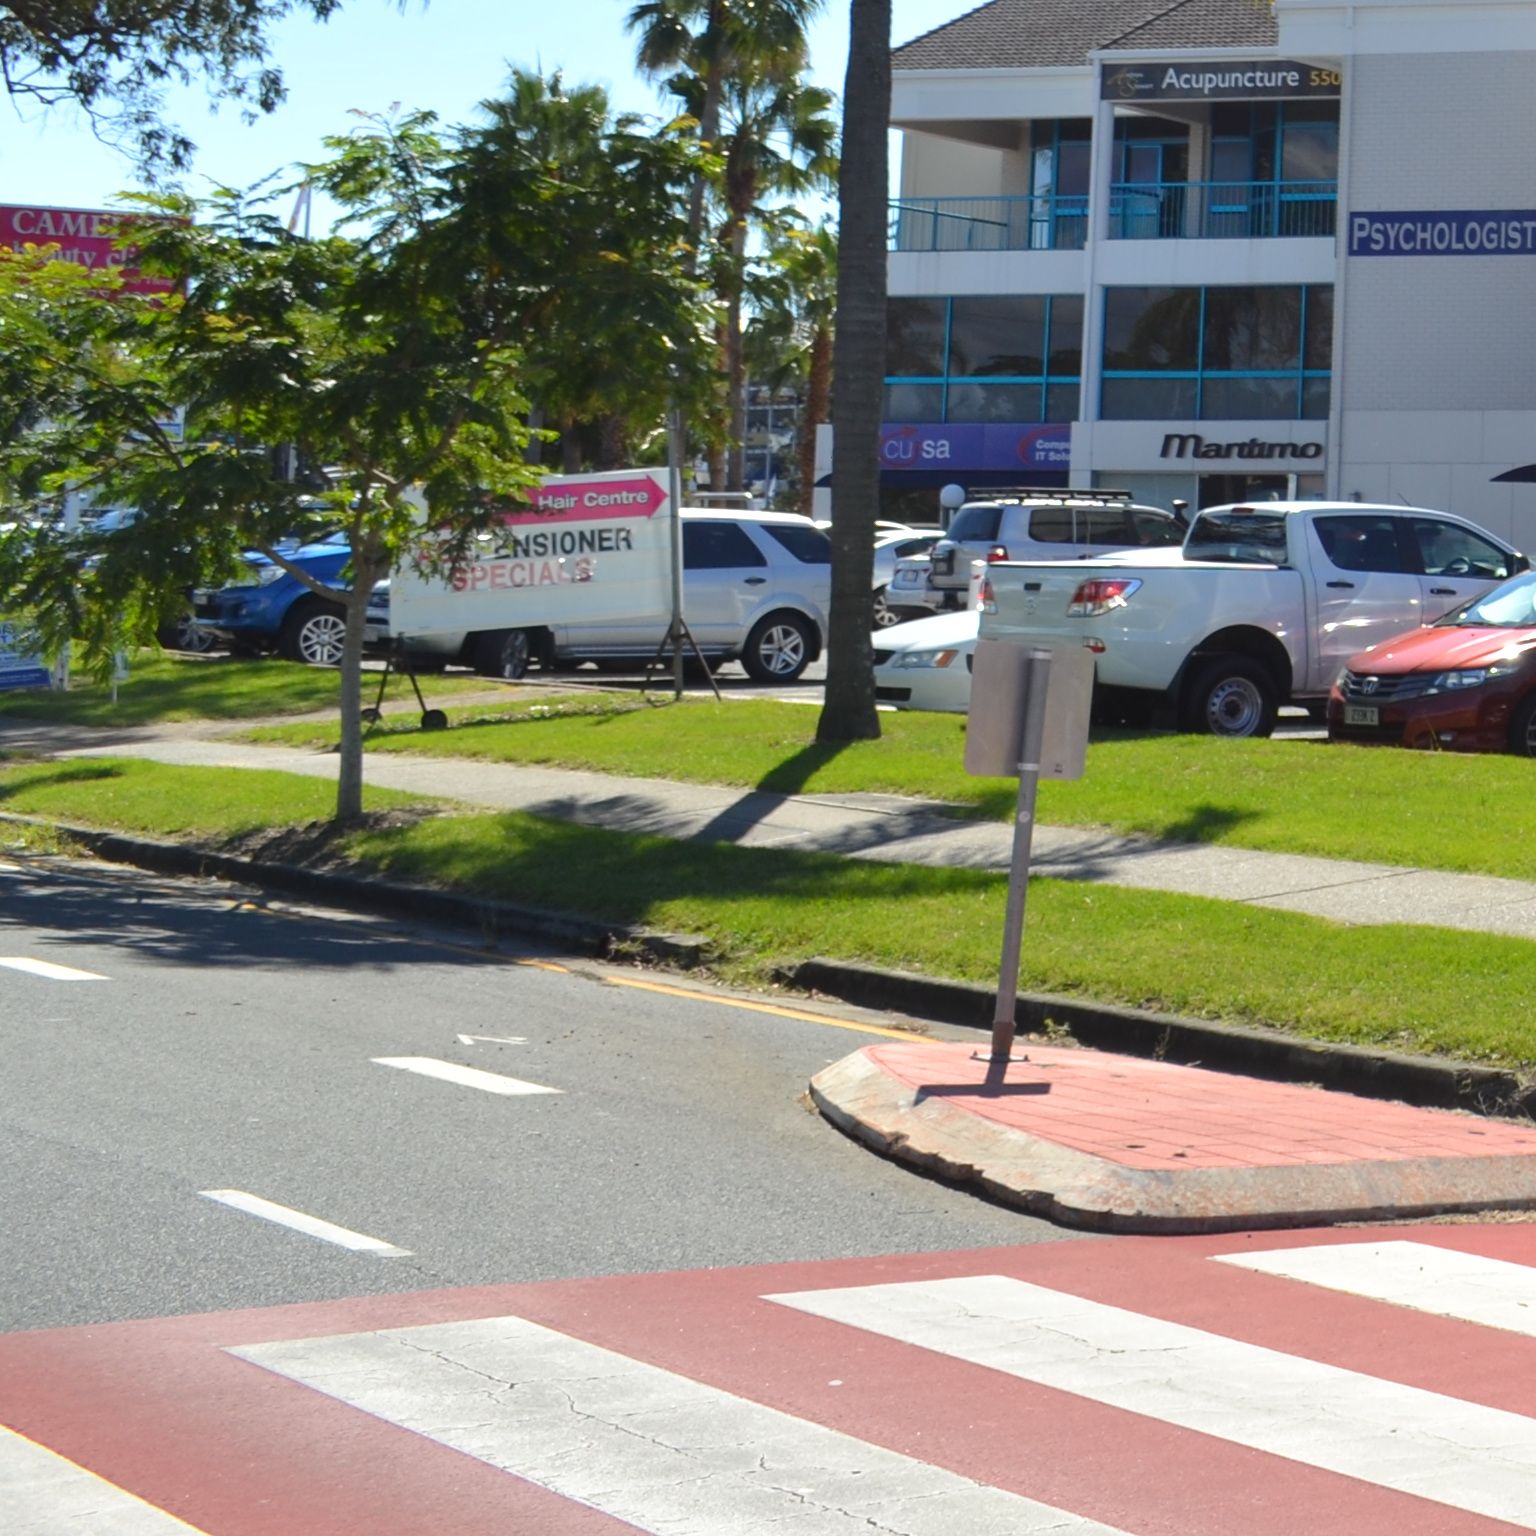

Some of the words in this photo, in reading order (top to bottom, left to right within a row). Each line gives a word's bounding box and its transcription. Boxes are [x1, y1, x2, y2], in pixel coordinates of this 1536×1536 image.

[1161, 67, 1300, 94] Acupuncture
[1309, 70, 1342, 87] 550
[1035, 451, 1047, 461] IT
[538, 494, 580, 511] Hair
[583, 490, 649, 508] Centre
[476, 527, 633, 560] ENSIONER
